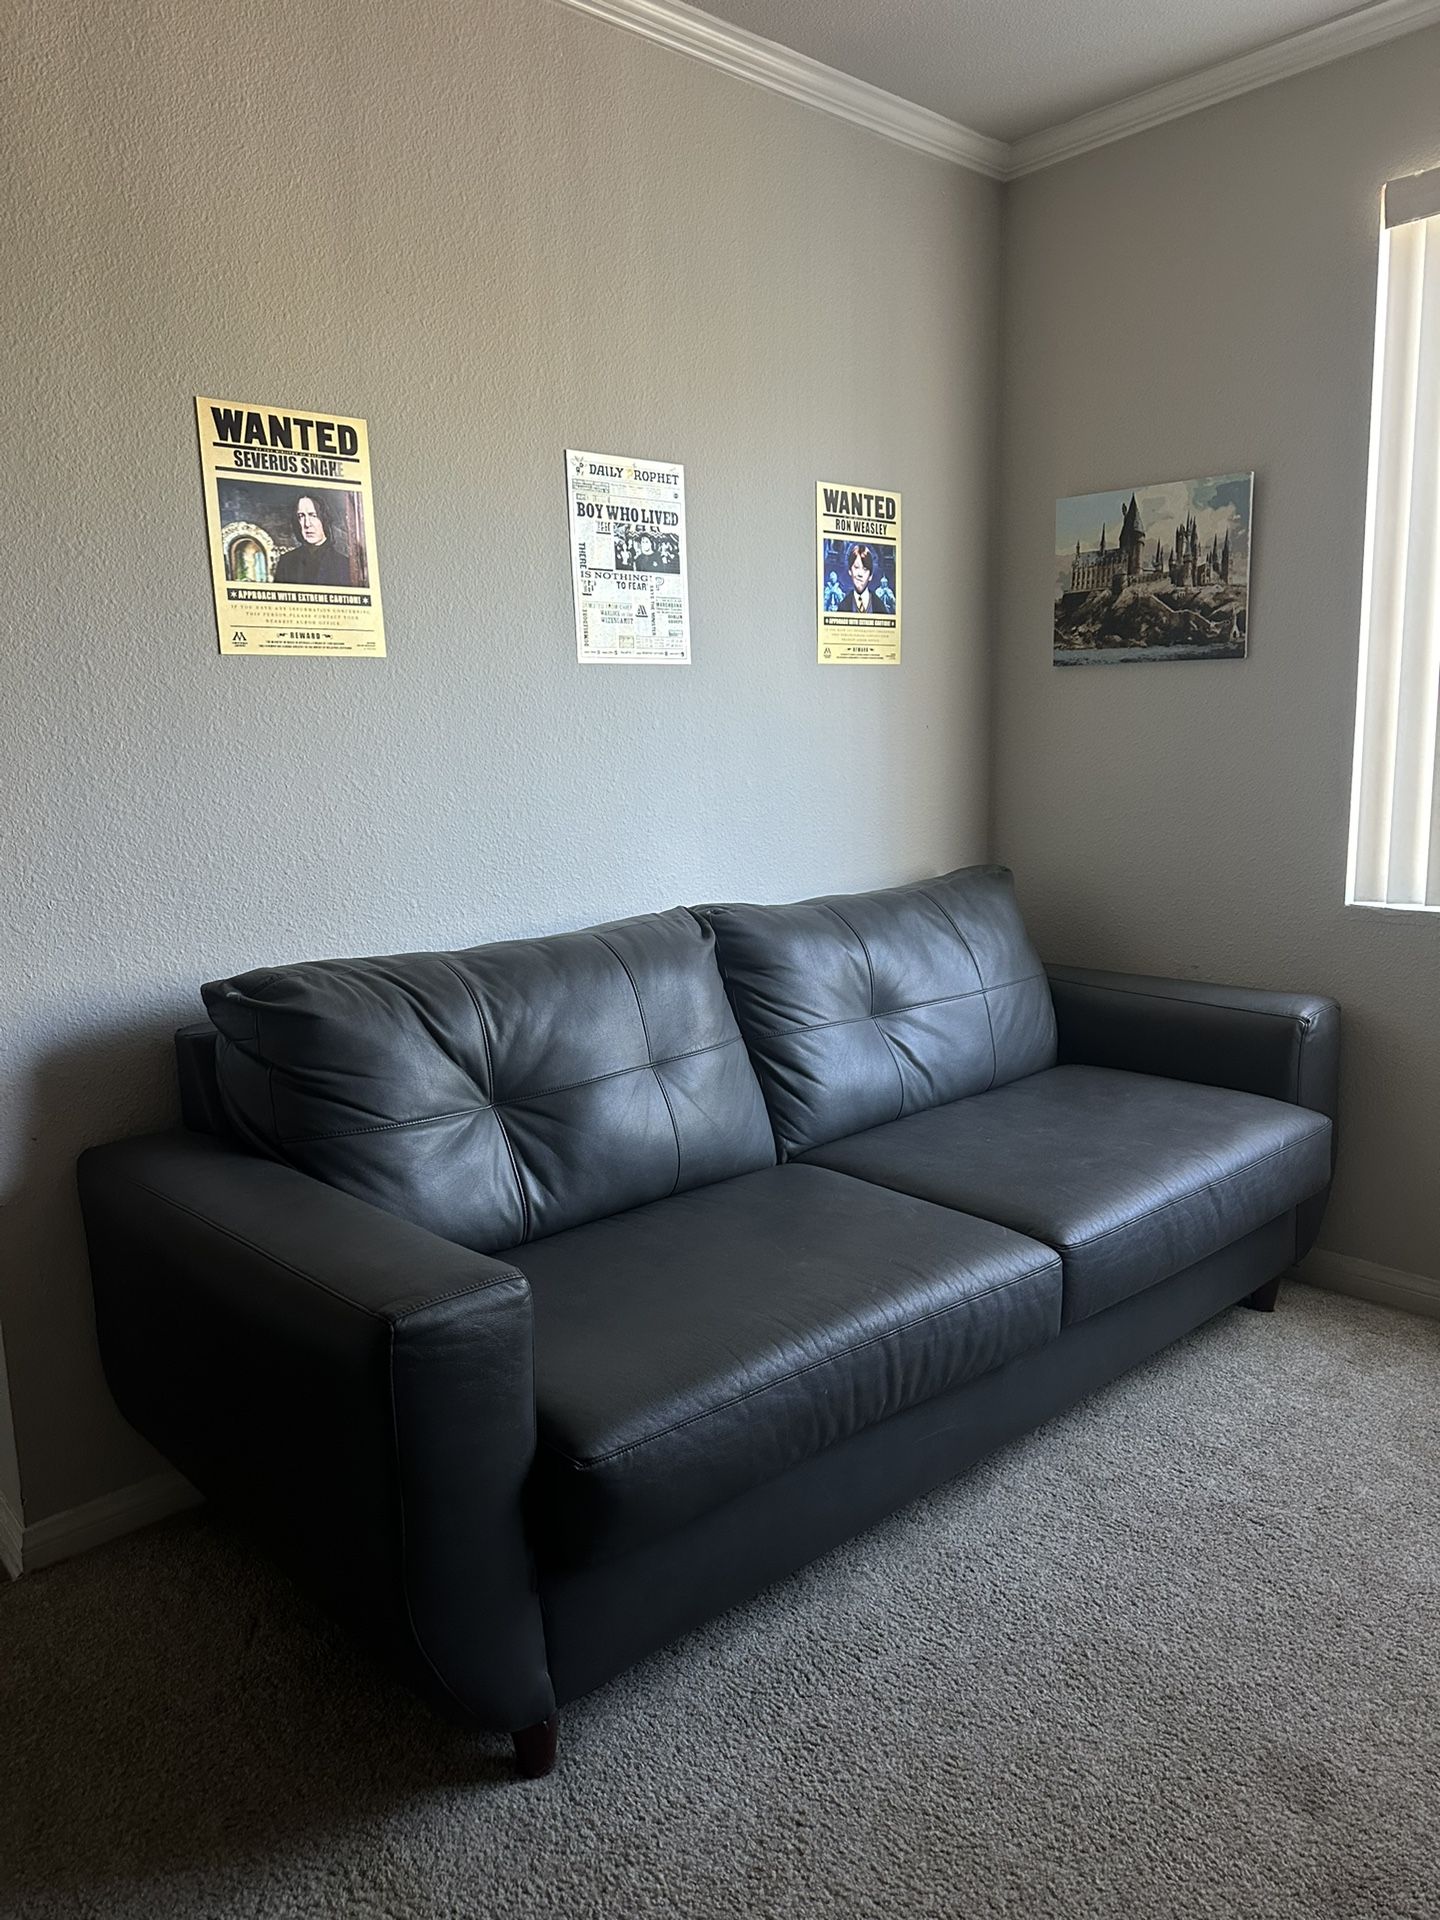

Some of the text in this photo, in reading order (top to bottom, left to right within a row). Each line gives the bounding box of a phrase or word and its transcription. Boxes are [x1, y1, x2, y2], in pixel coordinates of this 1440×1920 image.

[210, 406, 358, 456] WANTED
[233, 449, 298, 473] SEVERUS
[589, 463, 624, 478] DAILY
[823, 488, 896, 520] WANTED
[576, 501, 679, 526] BOY WHO LIVED
[836, 518, 851, 531] RON
[854, 520, 887, 535] WEASLEY
[581, 570, 648, 582] IS NOTHING
[616, 581, 647, 591] TO FEAR
[238, 590, 277, 600] APPROACH
[277, 591, 297, 601] WITH
[298, 592, 328, 603] EXTREME
